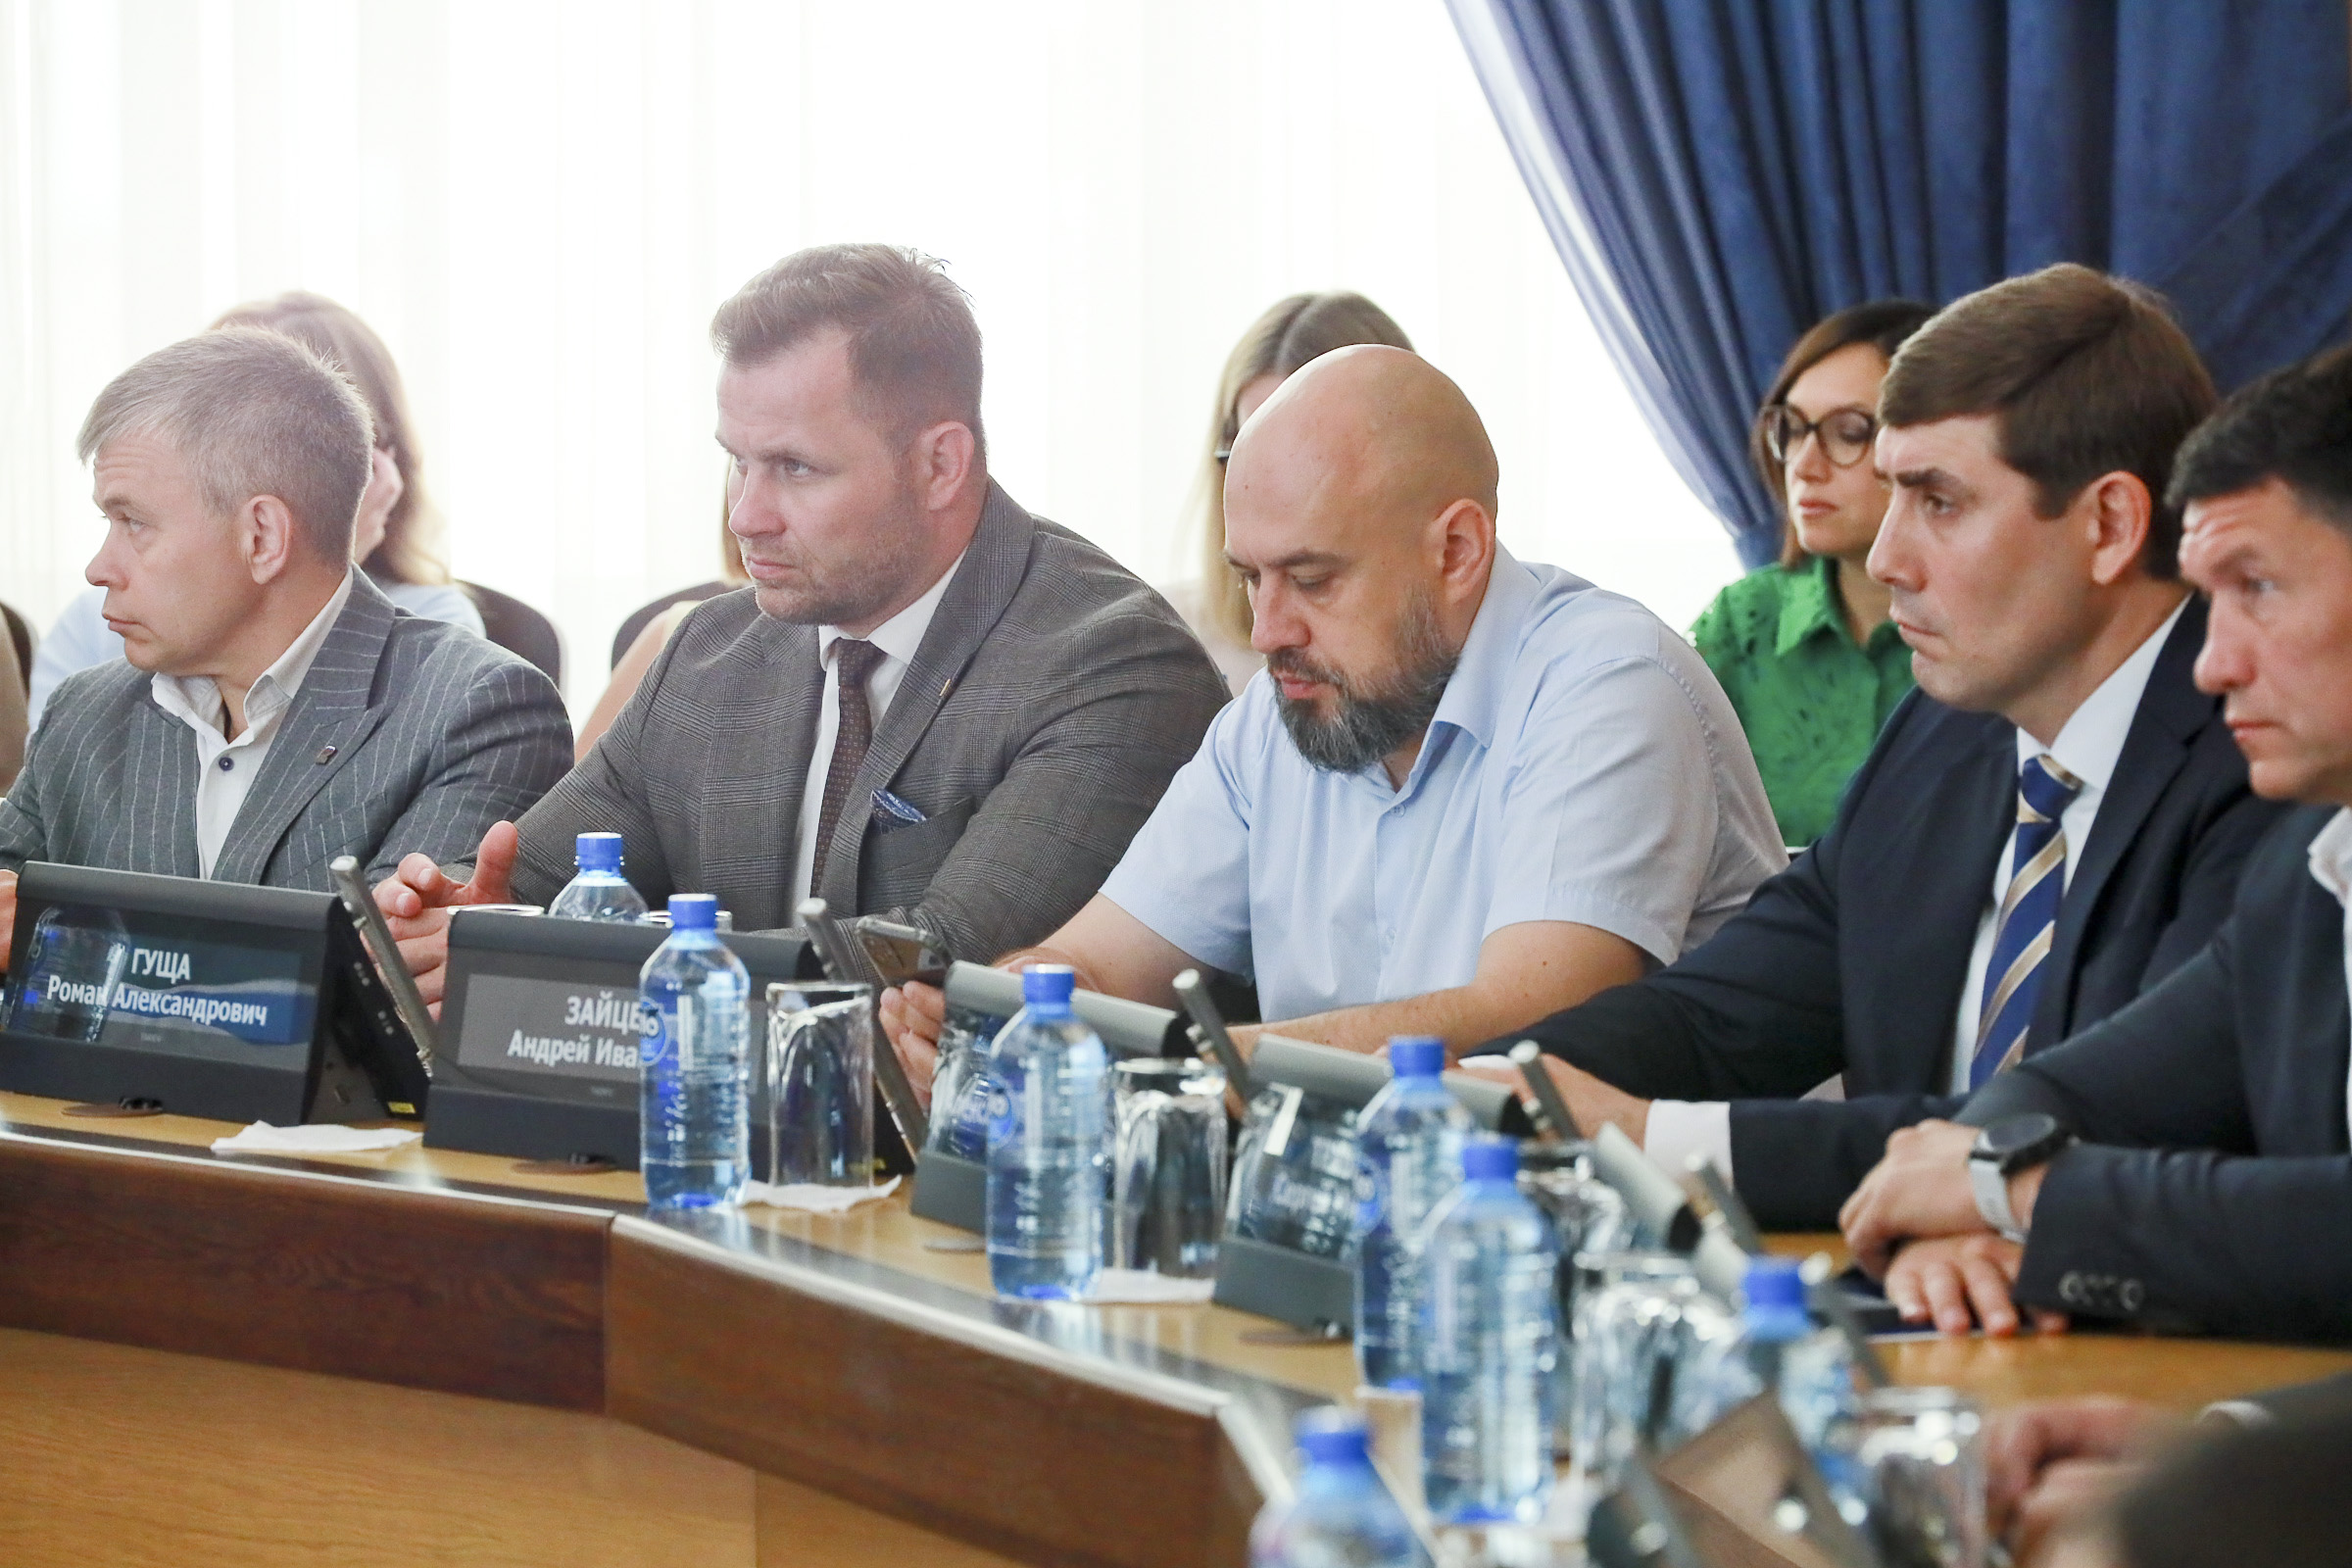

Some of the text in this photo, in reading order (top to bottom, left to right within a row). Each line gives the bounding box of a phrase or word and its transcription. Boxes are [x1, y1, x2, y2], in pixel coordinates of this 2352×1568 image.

[131, 948, 190, 984] ГУЩА
[112, 982, 267, 1026] Александрович
[564, 990, 641, 1036] ЗАЙЦЕ
[507, 1029, 638, 1069] Андрей Ива
